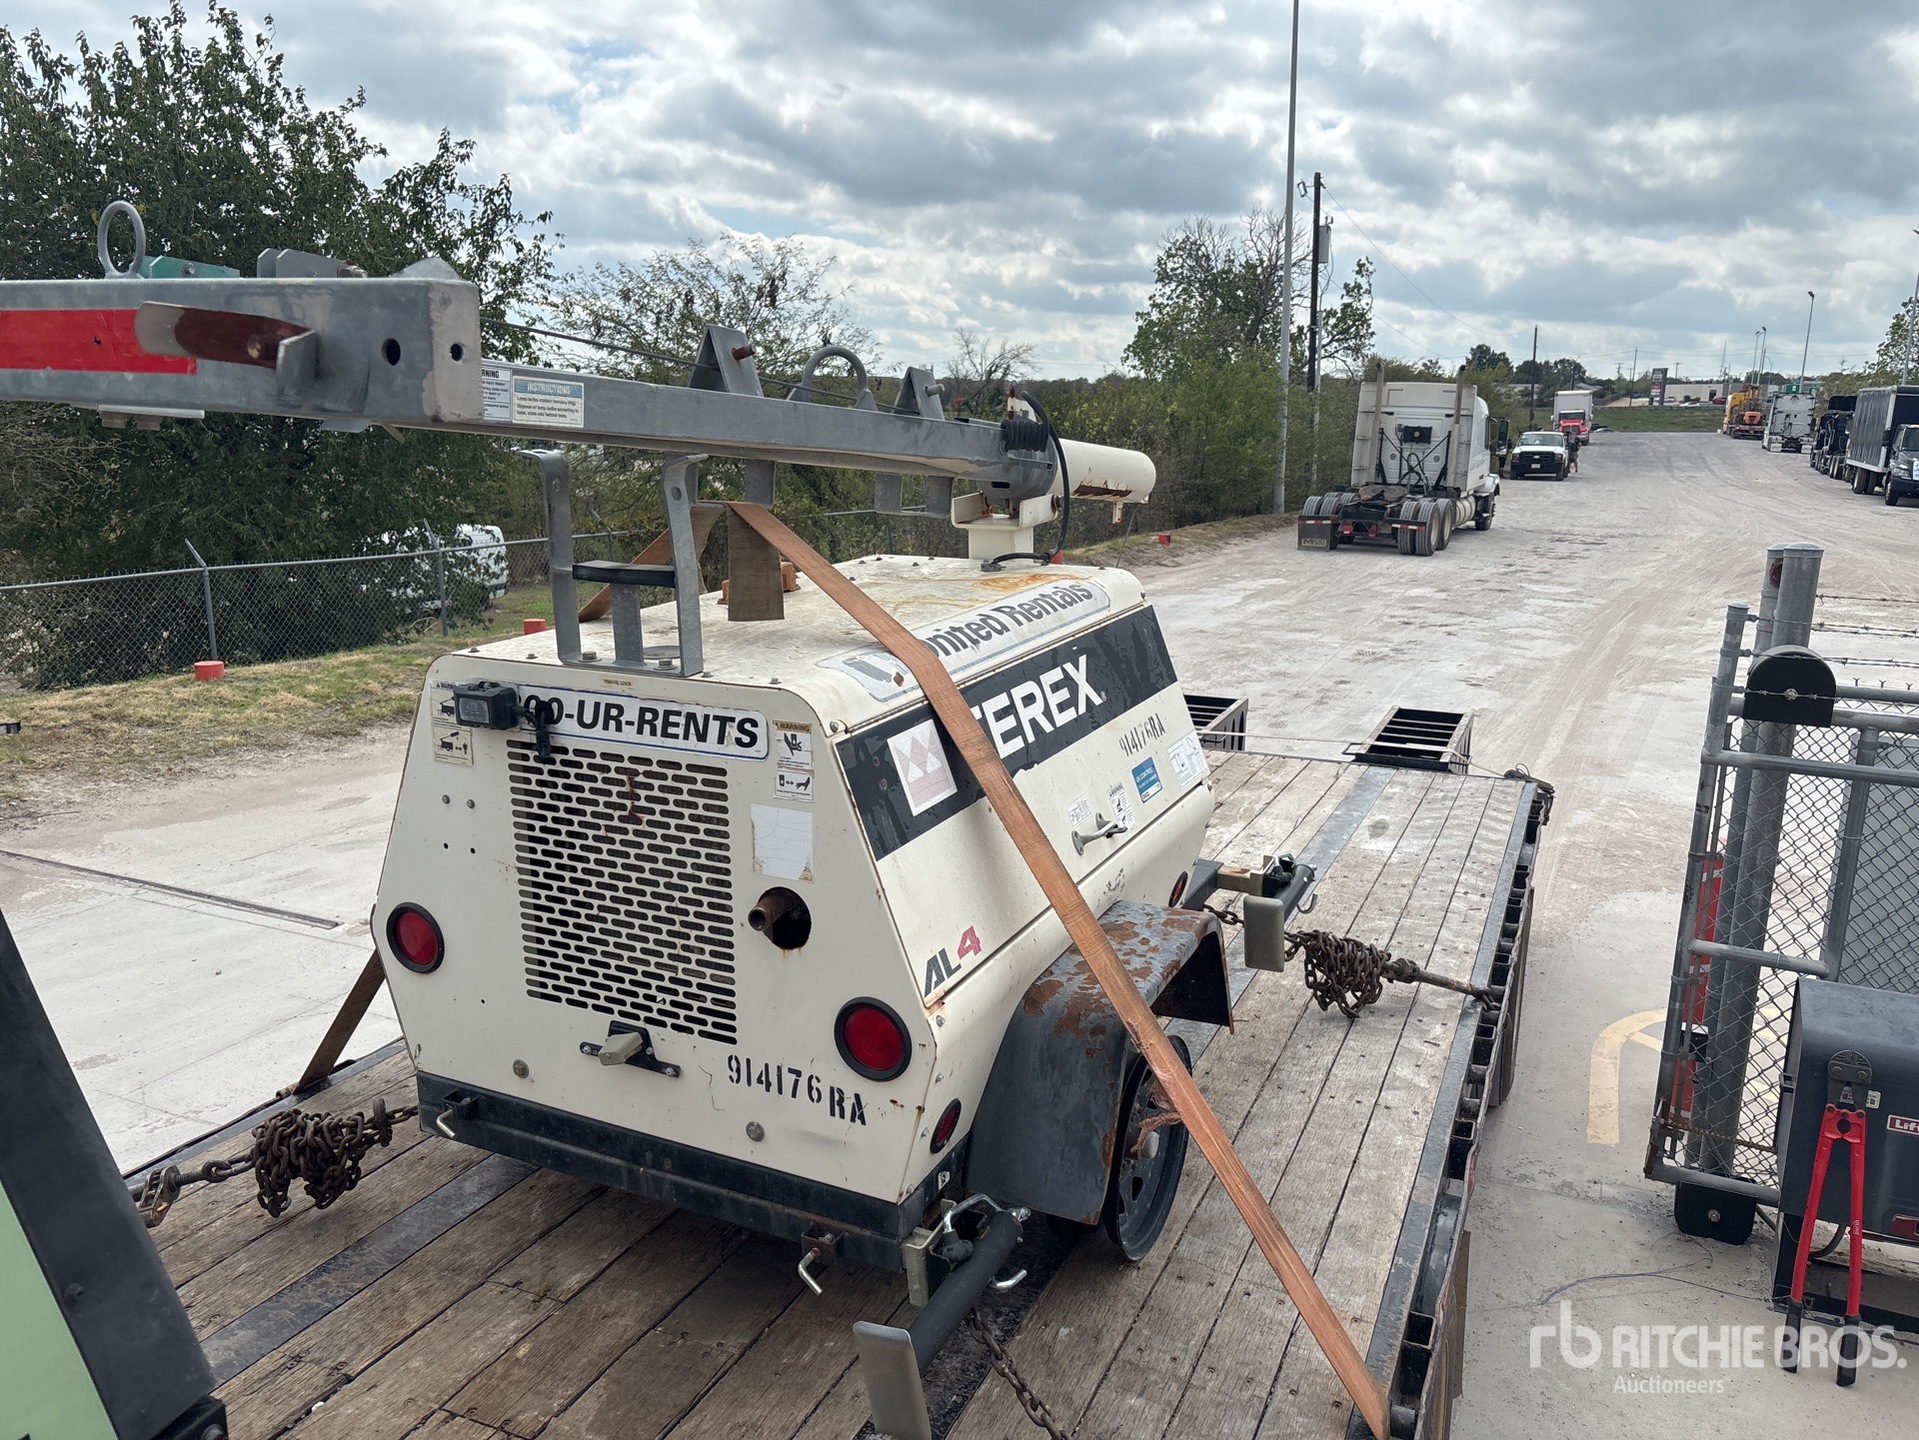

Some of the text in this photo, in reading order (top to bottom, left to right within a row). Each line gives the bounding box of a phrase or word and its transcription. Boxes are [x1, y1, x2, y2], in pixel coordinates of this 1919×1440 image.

[482, 369, 500, 379] RNING
[527, 382, 571, 395] INSTRUCTIONS
[921, 583, 1094, 659] nited Rentals
[518, 694, 759, 749] 00-UR-RENTS
[780, 722, 810, 732] WARNING
[727, 1054, 867, 1127] 914176RA
